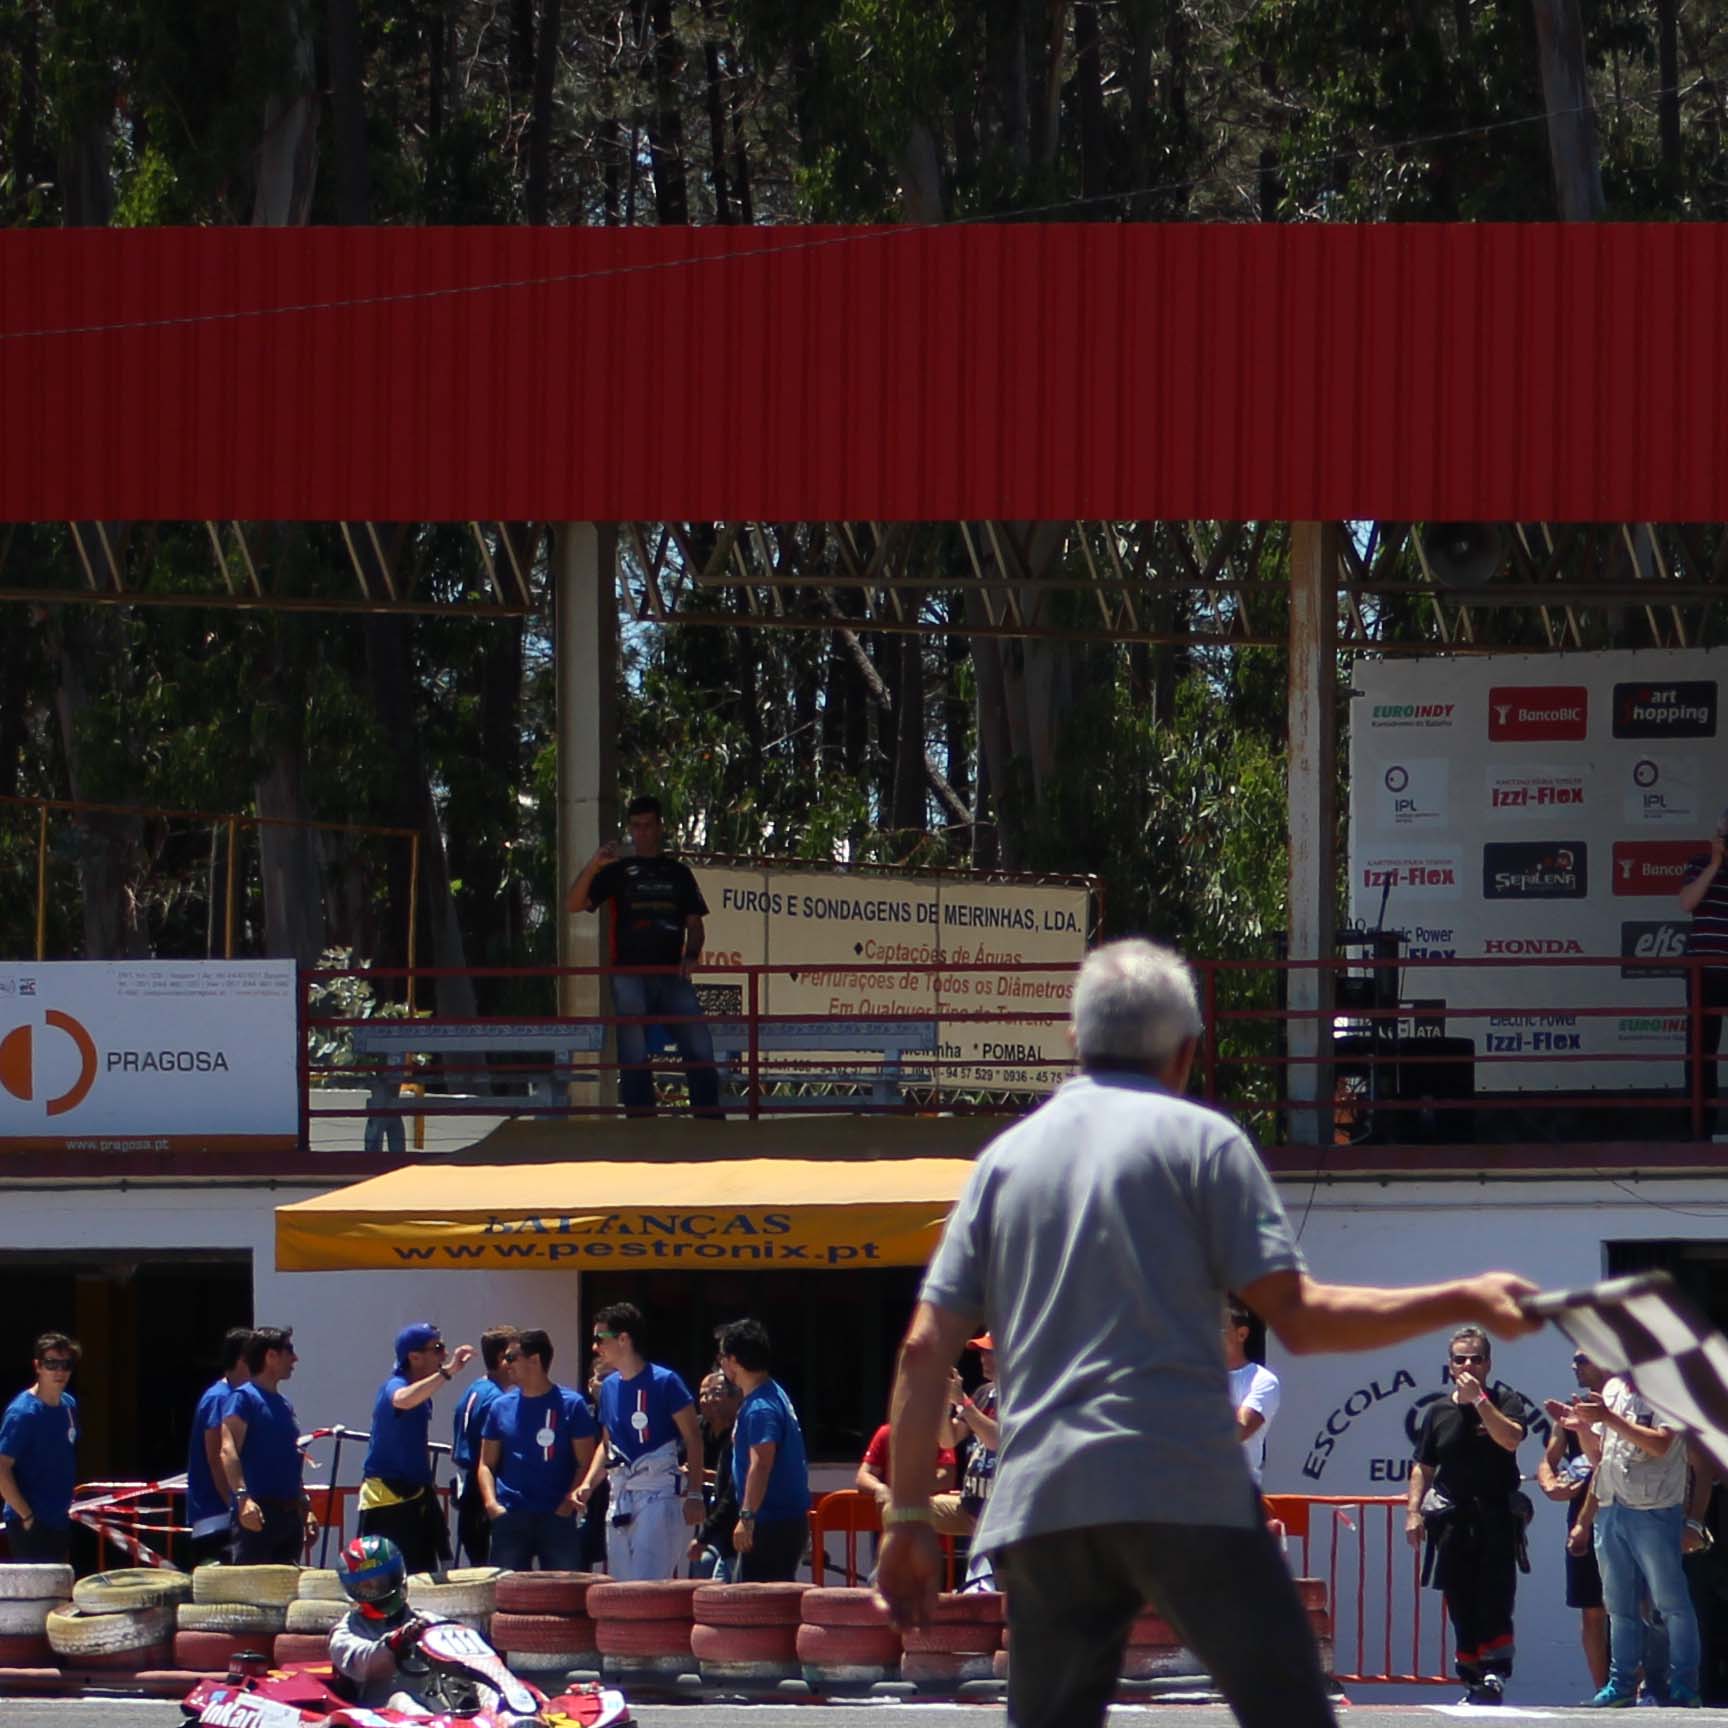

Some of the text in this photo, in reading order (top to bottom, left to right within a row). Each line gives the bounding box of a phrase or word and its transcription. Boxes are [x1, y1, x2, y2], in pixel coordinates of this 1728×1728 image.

[1518, 707, 1582, 722] BancoBIC
[1395, 800, 1417, 812] IPL
[1643, 794, 1668, 808] IPL
[722, 888, 782, 915] FUROS
[787, 894, 798, 916] E
[803, 897, 911, 923] SONDAGENS
[917, 902, 938, 925] DE
[1044, 910, 1082, 934] LDA.
[1416, 927, 1454, 942] Power
[865, 939, 946, 966] Captações
[952, 944, 970, 965] de
[1484, 939, 1584, 954] HONDA
[899, 972, 918, 991] de
[975, 979, 992, 995] os
[996, 975, 1073, 1000] Diâmetros
[829, 998, 853, 1016] Em
[107, 1051, 229, 1072] PRAGOSA
[983, 1043, 1045, 1062] POMBAL
[65, 1138, 170, 1152] www.pragosa.pt
[392, 1239, 881, 1264] www.pestronix.pt
[1302, 1369, 1417, 1480] ESCOLA
